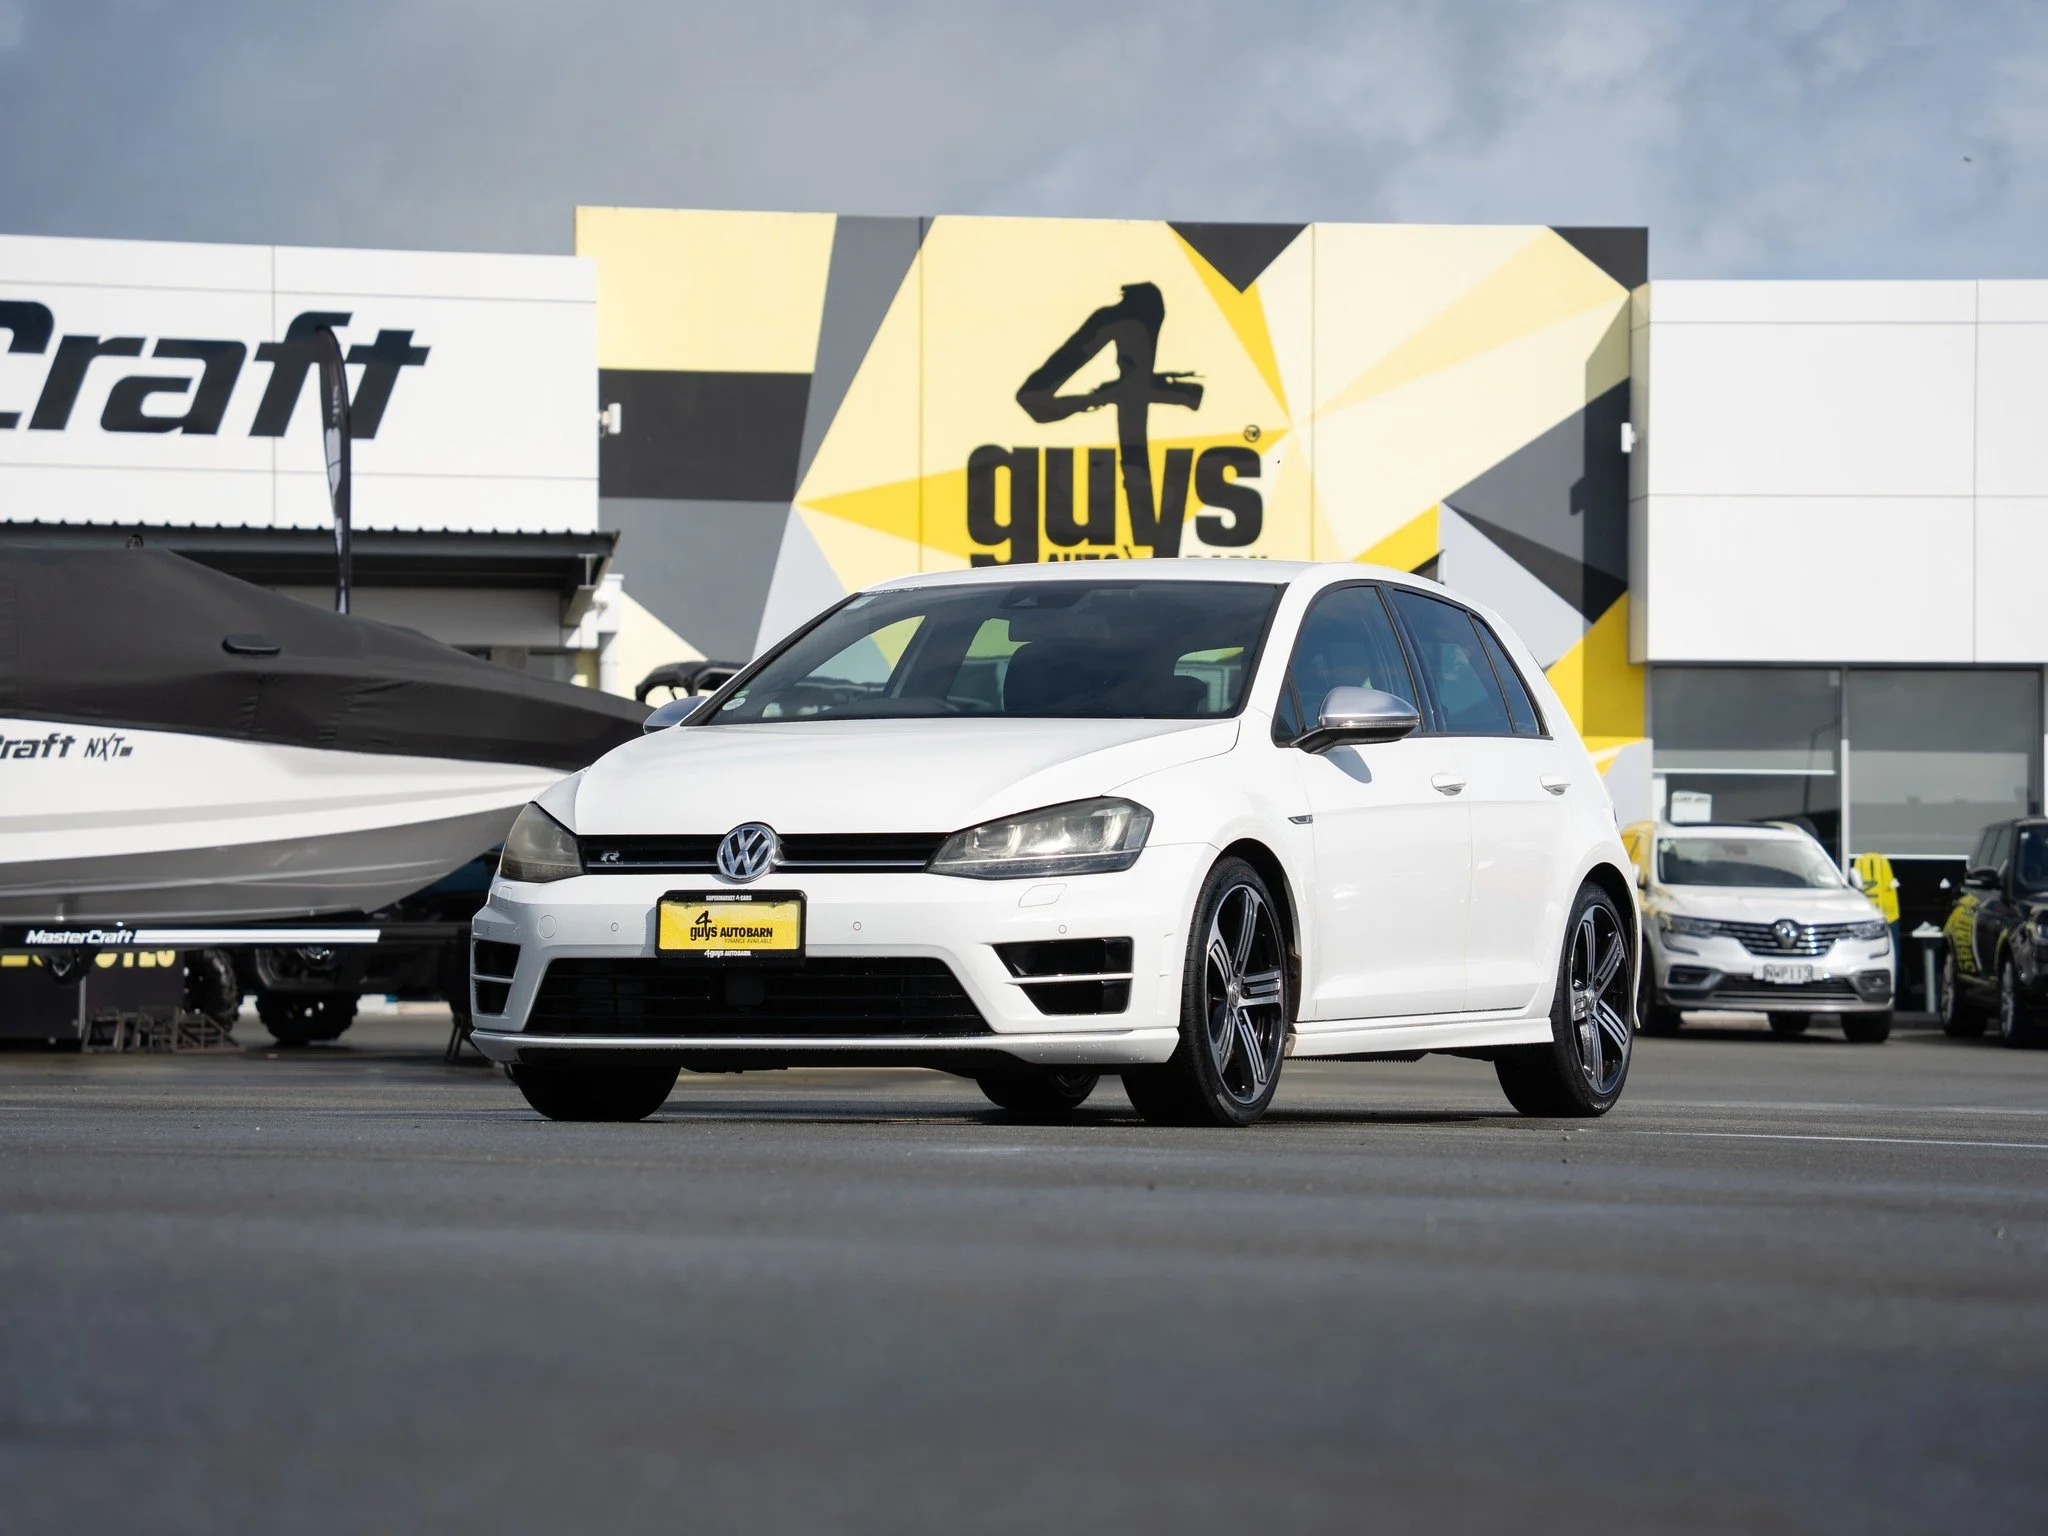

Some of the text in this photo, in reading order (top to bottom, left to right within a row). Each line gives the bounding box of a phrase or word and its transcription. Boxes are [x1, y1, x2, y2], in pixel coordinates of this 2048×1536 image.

[1015, 281, 1206, 480] 4
[967, 444, 1263, 569] guys
[0, 732, 76, 759] raft
[695, 910, 712, 930] 4
[26, 929, 134, 945] MasterCraft
[690, 926, 773, 941] guys AUTOBARN
